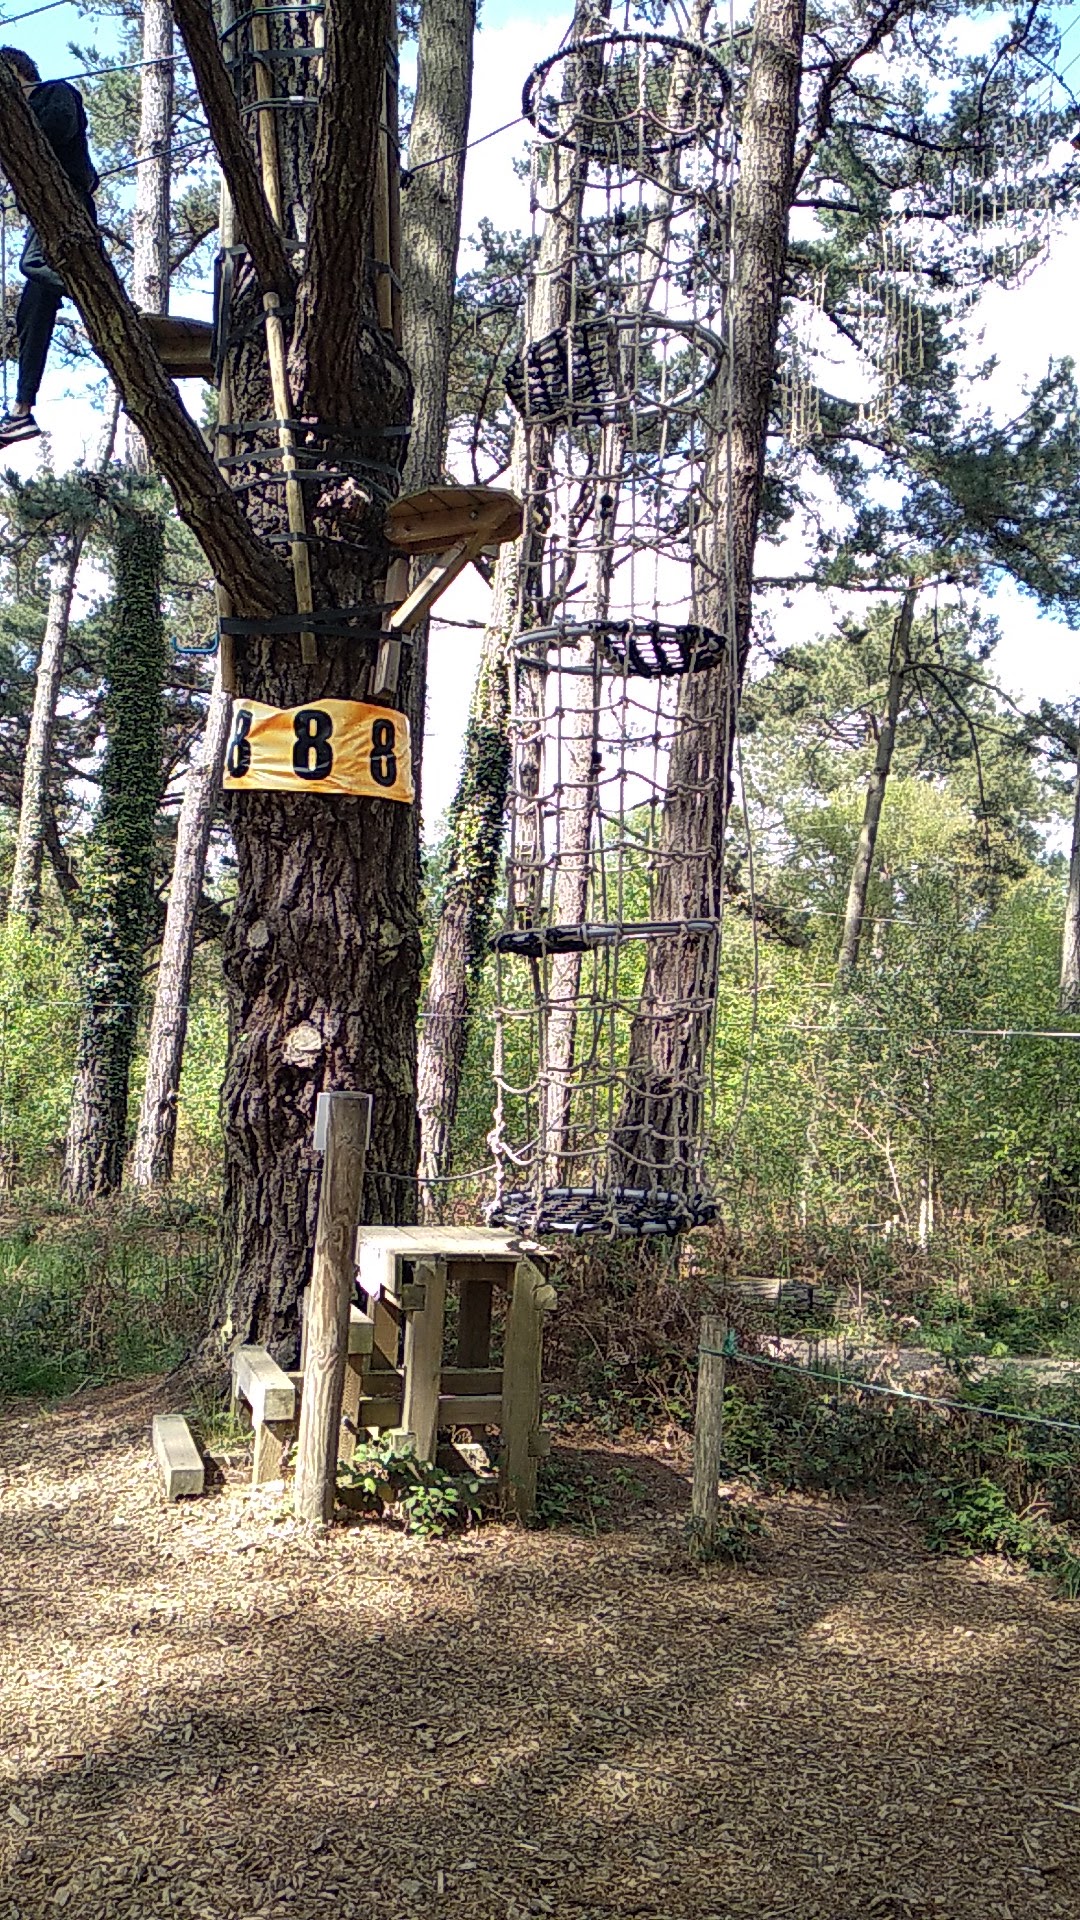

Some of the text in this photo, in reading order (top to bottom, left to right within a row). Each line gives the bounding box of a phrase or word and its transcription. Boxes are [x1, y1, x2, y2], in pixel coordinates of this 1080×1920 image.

[228, 709, 397, 787] 8 8 8
